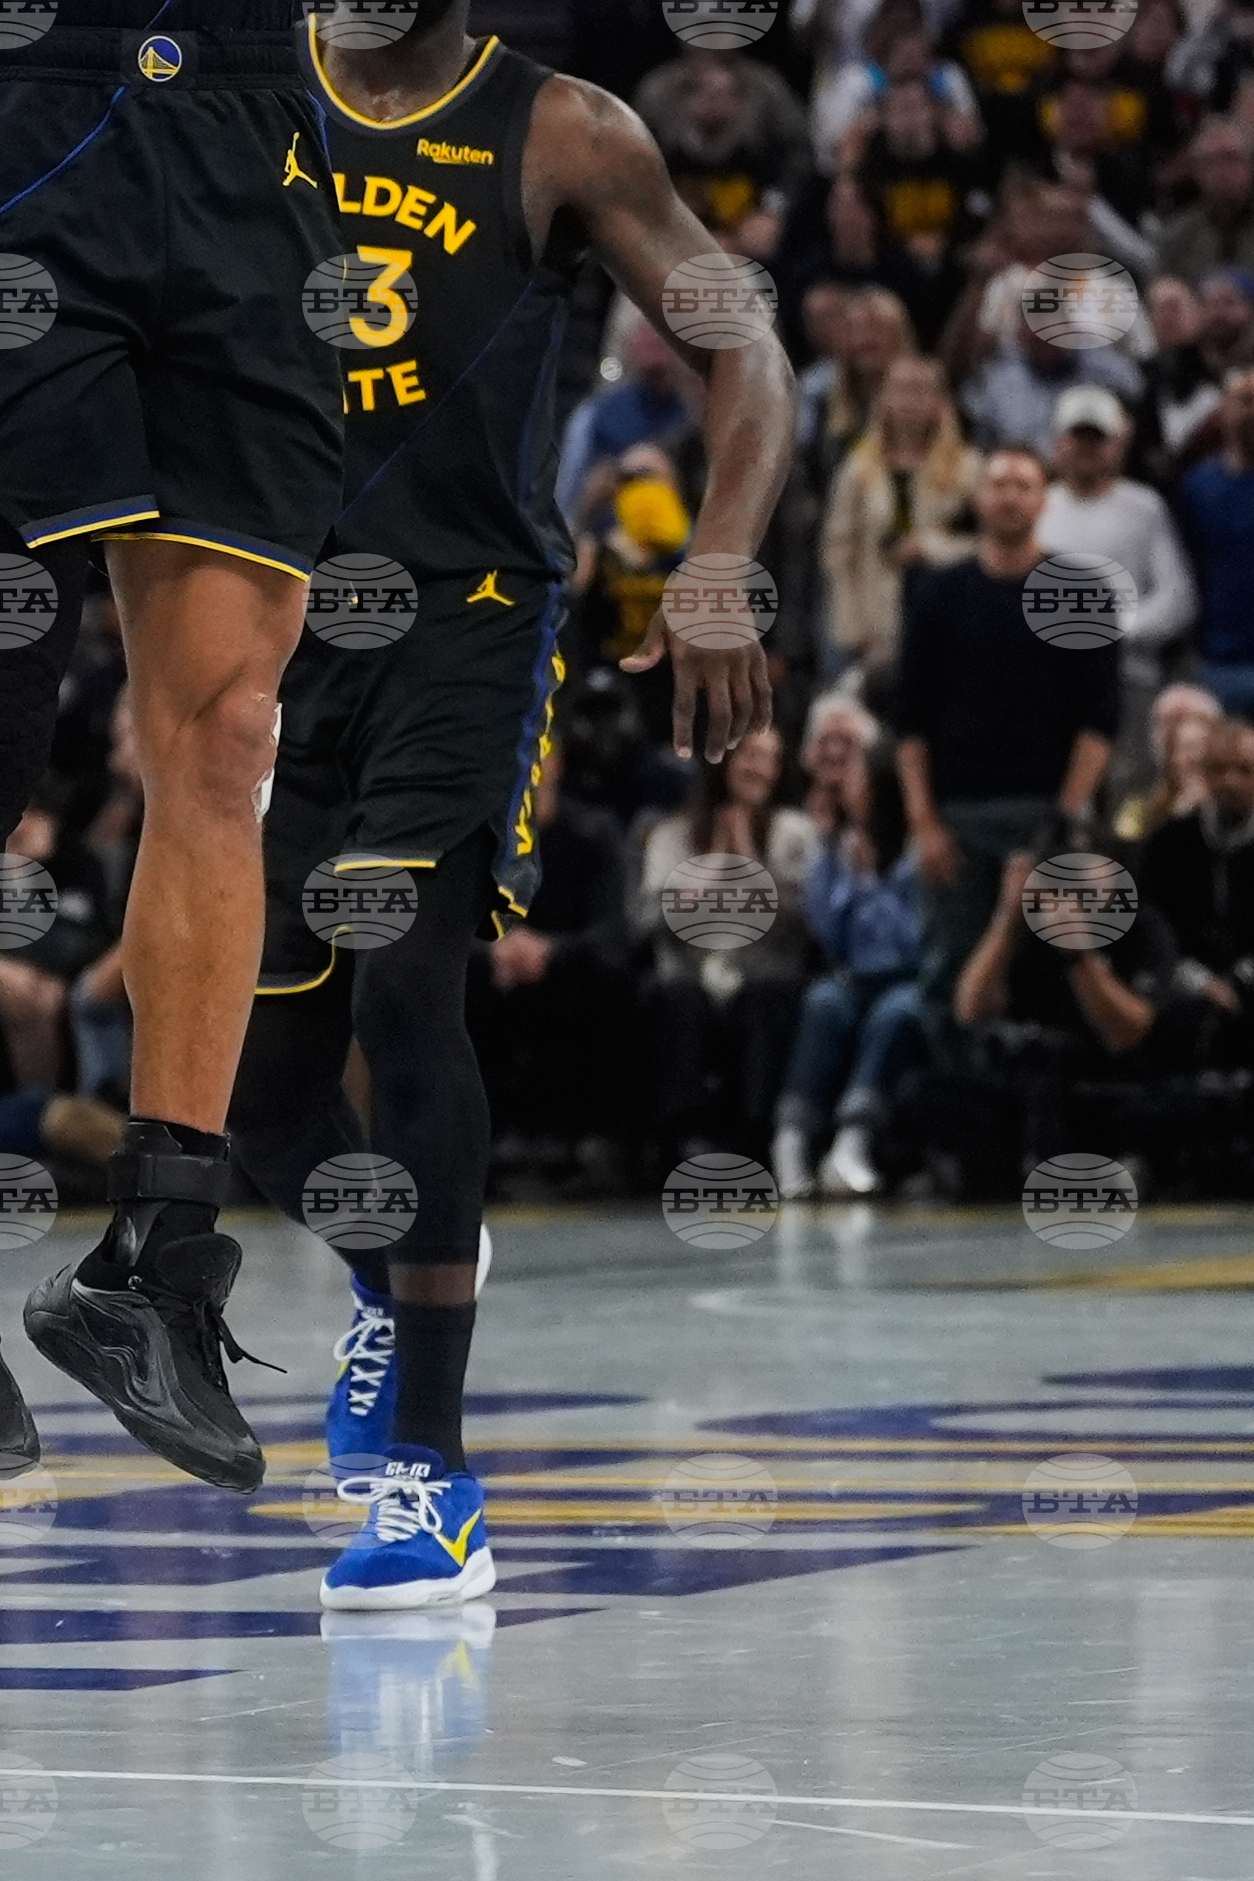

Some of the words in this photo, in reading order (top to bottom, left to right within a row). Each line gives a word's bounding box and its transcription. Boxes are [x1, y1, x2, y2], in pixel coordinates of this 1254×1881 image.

[416, 138, 494, 166] Rakuten
[343, 244, 414, 348] 3
[343, 360, 427, 414] TE
